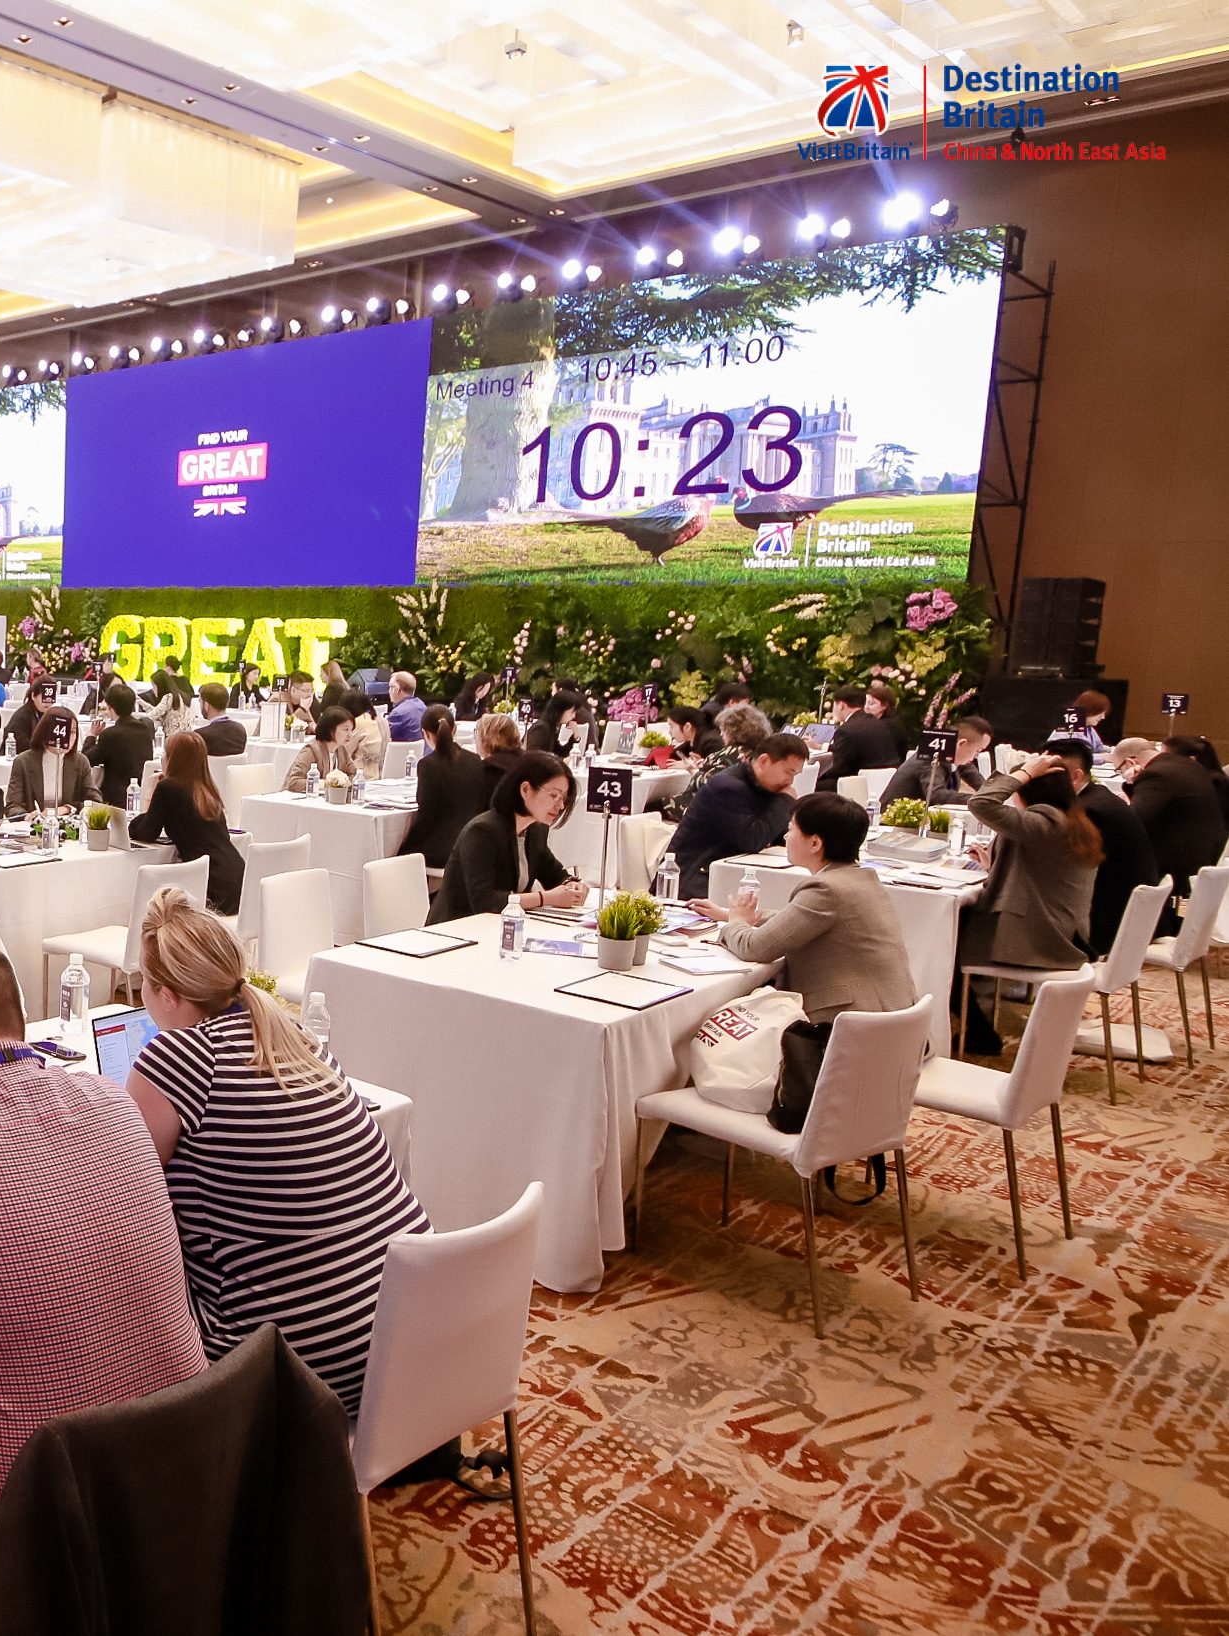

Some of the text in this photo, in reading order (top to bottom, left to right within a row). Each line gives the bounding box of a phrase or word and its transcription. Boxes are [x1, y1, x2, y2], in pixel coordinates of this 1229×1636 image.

[580, 350, 658, 384] 10:45
[700, 335, 785, 369] 11:00
[435, 370, 535, 400] Meeting 4
[198, 429, 248, 446] FIND YOUR
[521, 405, 803, 503] 10:23
[181, 448, 263, 481] GREAT
[202, 483, 238, 497] BRITAIN
[819, 519, 914, 536] Destination
[816, 536, 871, 553] Britain
[743, 557, 800, 568] VisitBritain
[815, 555, 936, 568] China & North East Asia
[99, 614, 348, 692] GREAT
[44, 688, 54, 696] 39
[520, 704, 531, 714] 40
[1168, 700, 1181, 708] 13
[1063, 714, 1078, 723] 16
[52, 724, 67, 737] 44
[928, 738, 946, 750] 41
[596, 780, 622, 798] 43
[703, 1022, 724, 1038] BRITAIN
[712, 1010, 756, 1038] REAT
